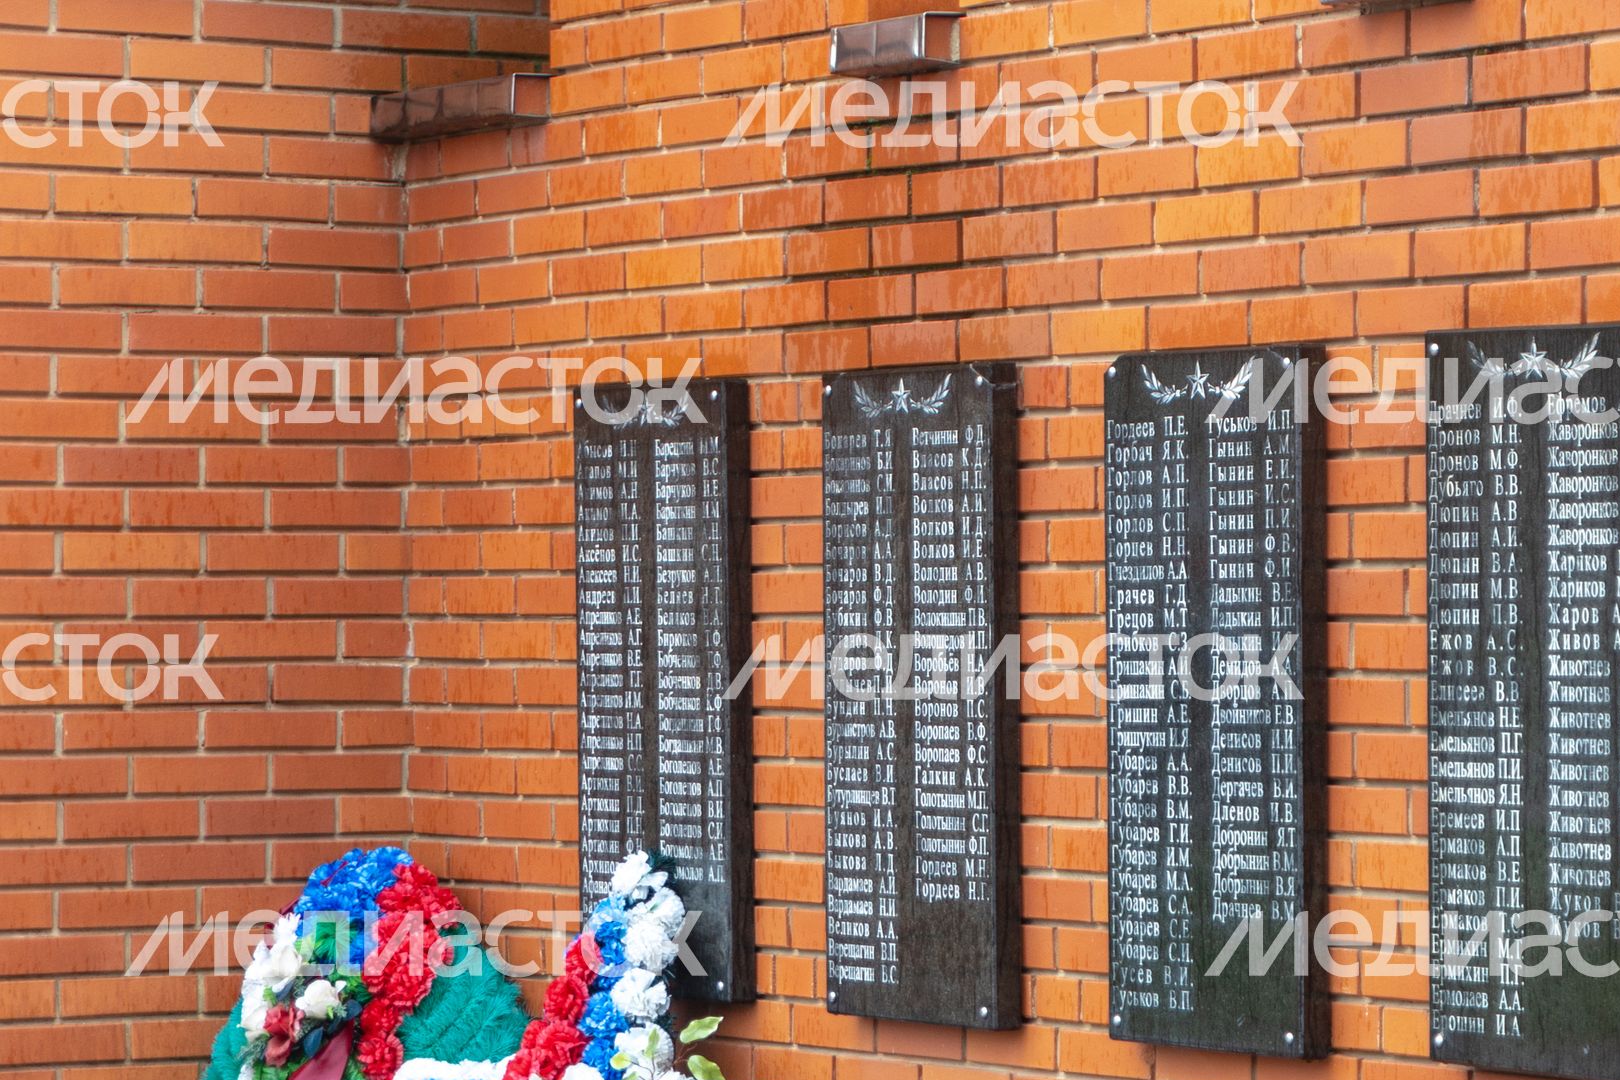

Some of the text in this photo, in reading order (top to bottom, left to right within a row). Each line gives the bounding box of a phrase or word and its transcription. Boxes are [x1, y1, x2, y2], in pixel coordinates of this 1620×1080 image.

[1107, 416, 1188, 443] Гордеев П.Е.
[1429, 425, 1522, 452] Дронов М.Н.
[1107, 440, 1188, 467] Горбач Я.К.
[913, 473, 953, 491] Власов
[1107, 464, 1189, 491] Горлов А.П.
[1209, 459, 1294, 482] Гынин Е.И.
[1429, 475, 1522, 503] Дубьяго В.В.
[1209, 508, 1294, 530] Гынин П.И.
[1548, 499, 1618, 524] Жаворонков
[913, 541, 954, 559] Волков
[1430, 527, 1522, 551] Дюпин А.И.
[913, 563, 987, 584] Володин А.В.
[1109, 584, 1190, 609] Грачев Г.Д.
[1549, 604, 1599, 630] Жаров
[1430, 630, 1523, 651] Ежов А.С.
[1549, 629, 1600, 650] Живов
[1549, 681, 1610, 702] Животнев
[1110, 705, 1191, 729] Гришин А.Е.
[827, 764, 868, 785] Буслаев
[915, 766, 988, 787] Галкин А.К.
[1431, 756, 1523, 779] Емельянов П.И.
[1213, 801, 1297, 824] Дленов И.В.
[827, 829, 897, 850] Быкова А.В.
[916, 878, 989, 903] Гордеев Н.Г.
[1112, 868, 1192, 895] Губарев М.А.
[829, 917, 898, 940] Великов А.А.
